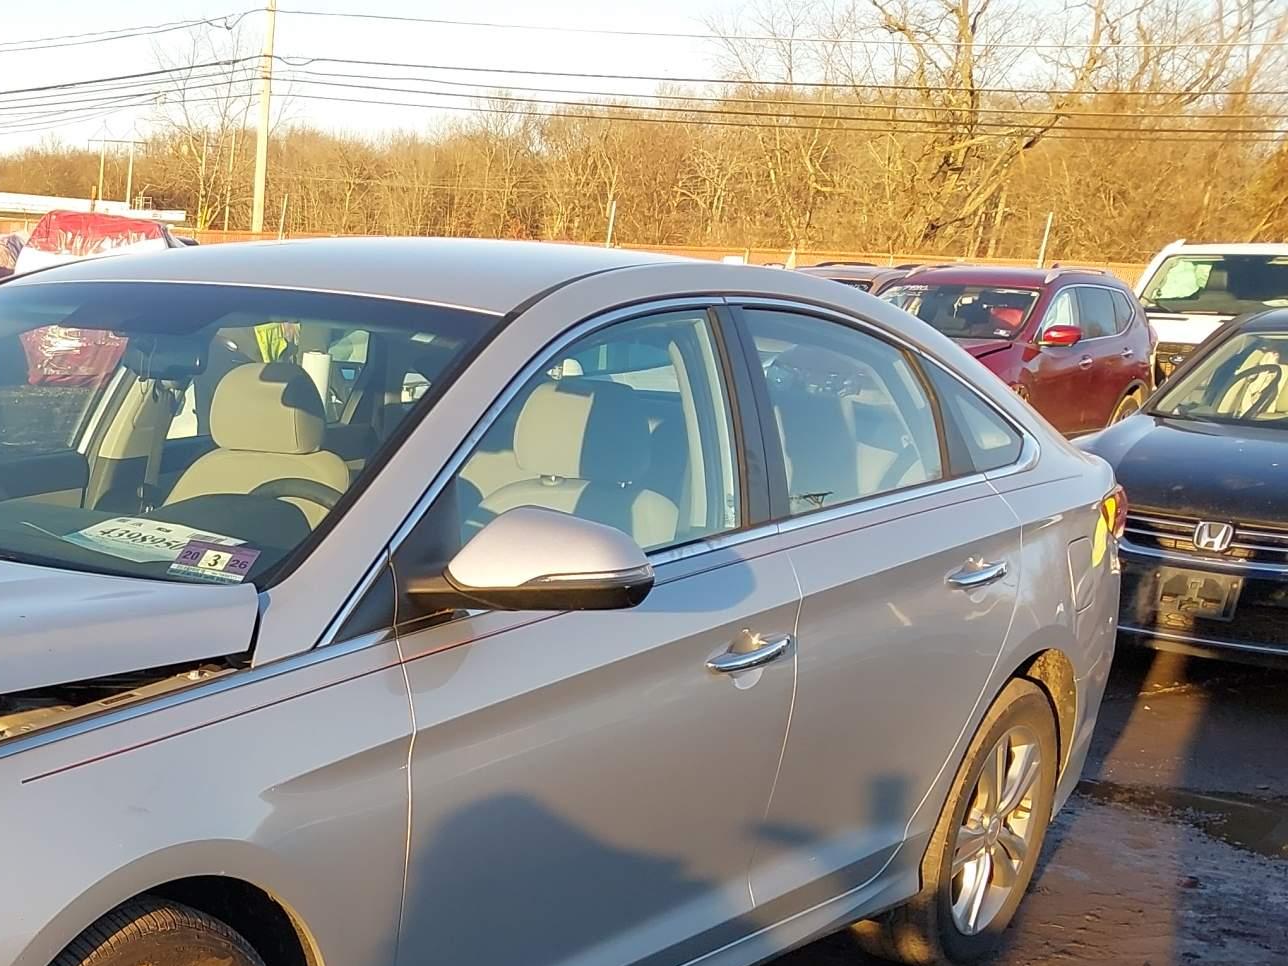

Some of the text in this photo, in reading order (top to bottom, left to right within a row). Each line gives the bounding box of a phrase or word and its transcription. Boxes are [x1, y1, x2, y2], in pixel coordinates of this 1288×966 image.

[182, 550, 249, 569] 20 3 26
